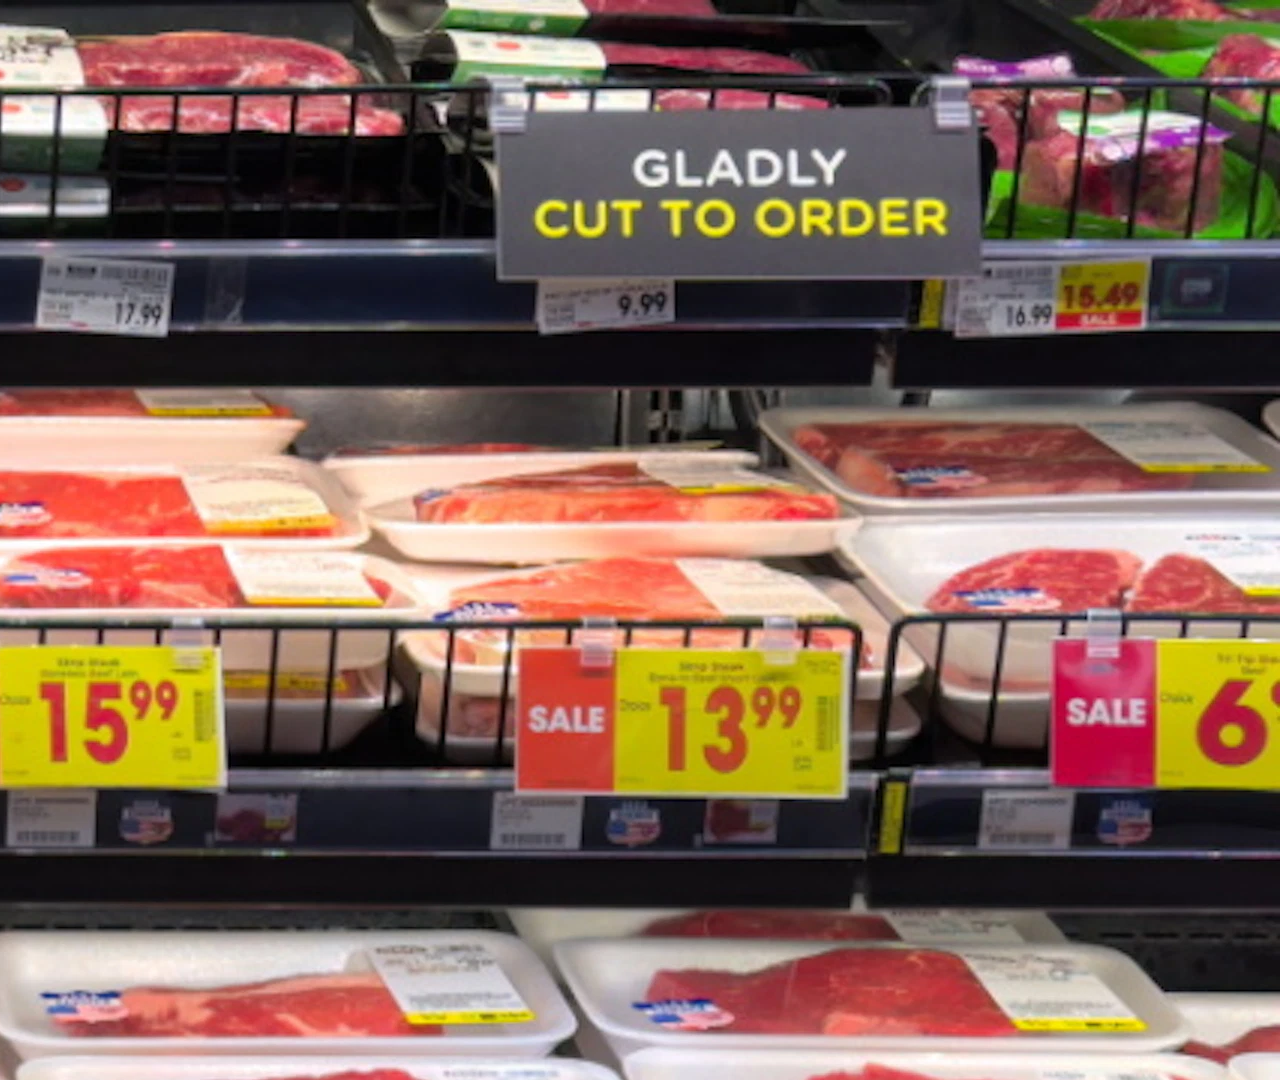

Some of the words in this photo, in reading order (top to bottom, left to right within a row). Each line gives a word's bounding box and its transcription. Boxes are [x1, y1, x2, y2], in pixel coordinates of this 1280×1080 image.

[632, 149, 846, 187] GLADLY
[534, 199, 642, 238] CUT
[661, 199, 737, 238] TO
[754, 198, 948, 238] ORDER
[618, 291, 666, 316] 9.99
[1064, 282, 1138, 311] 15.49
[1006, 304, 1052, 328] 16.99
[528, 705, 606, 733] SALE
[1066, 697, 1147, 727] SALE
